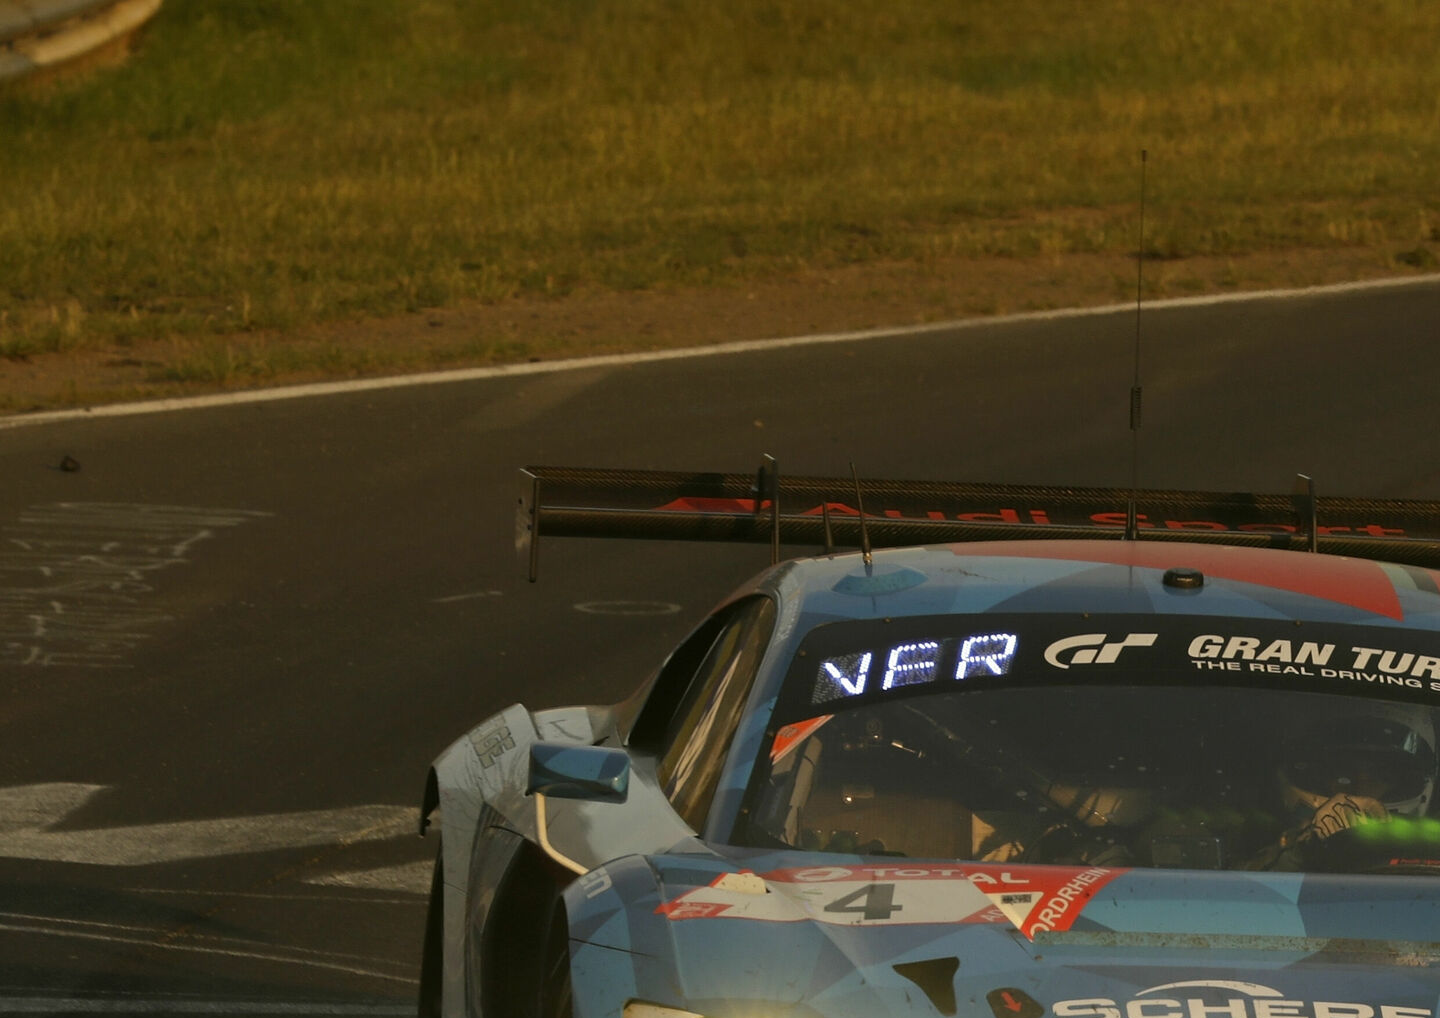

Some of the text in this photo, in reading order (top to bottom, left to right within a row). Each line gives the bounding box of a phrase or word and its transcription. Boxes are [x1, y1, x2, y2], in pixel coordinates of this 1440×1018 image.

[1187, 634, 1336, 667] GRAN
[1191, 660, 1242, 672] THE
[1249, 660, 1315, 677] REAL
[1320, 668, 1423, 690] DRIVING
[823, 883, 903, 921] 4
